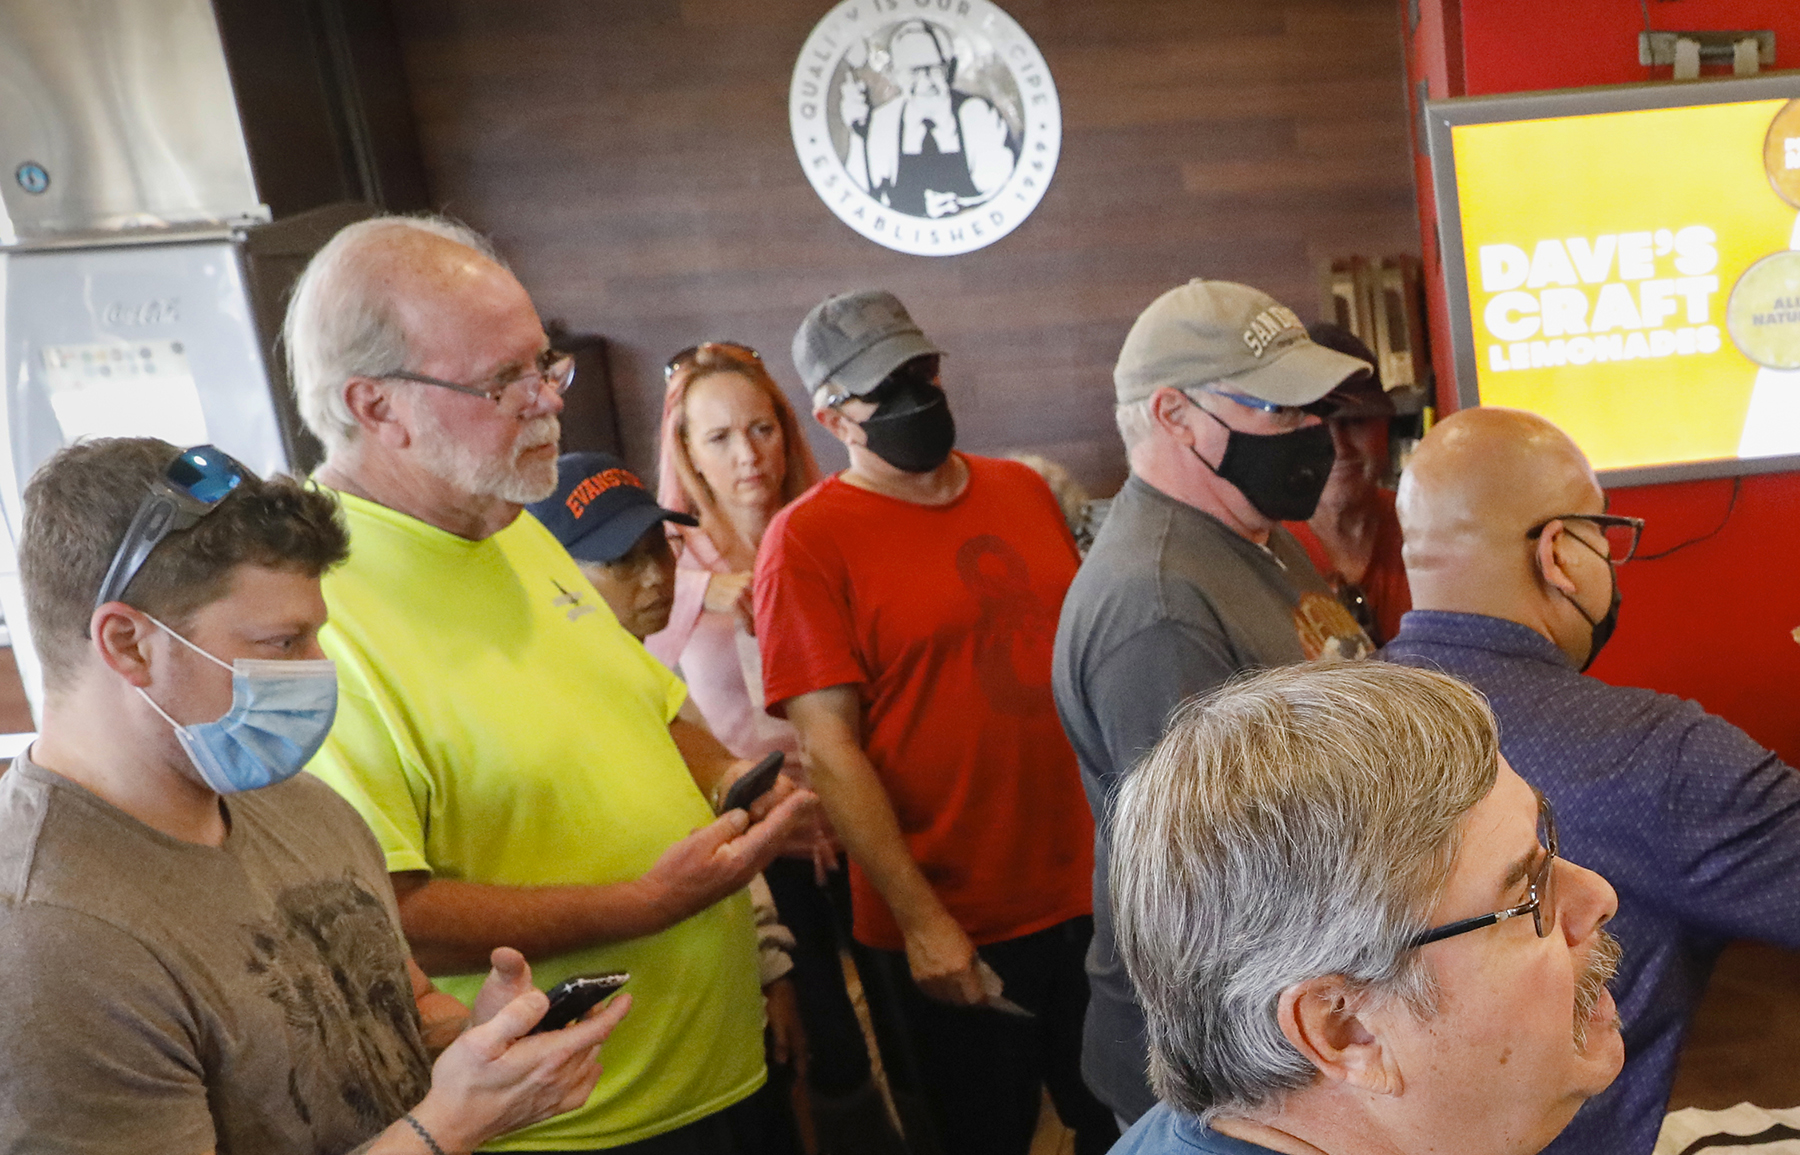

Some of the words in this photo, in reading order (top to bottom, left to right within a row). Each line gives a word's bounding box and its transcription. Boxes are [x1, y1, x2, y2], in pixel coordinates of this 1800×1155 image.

[813, 154, 1005, 244] ESTABLISHED
[1479, 226, 1718, 292] DAVE'S
[1483, 276, 1719, 341] CRAFT
[1489, 326, 1721, 371] LEMONADES
